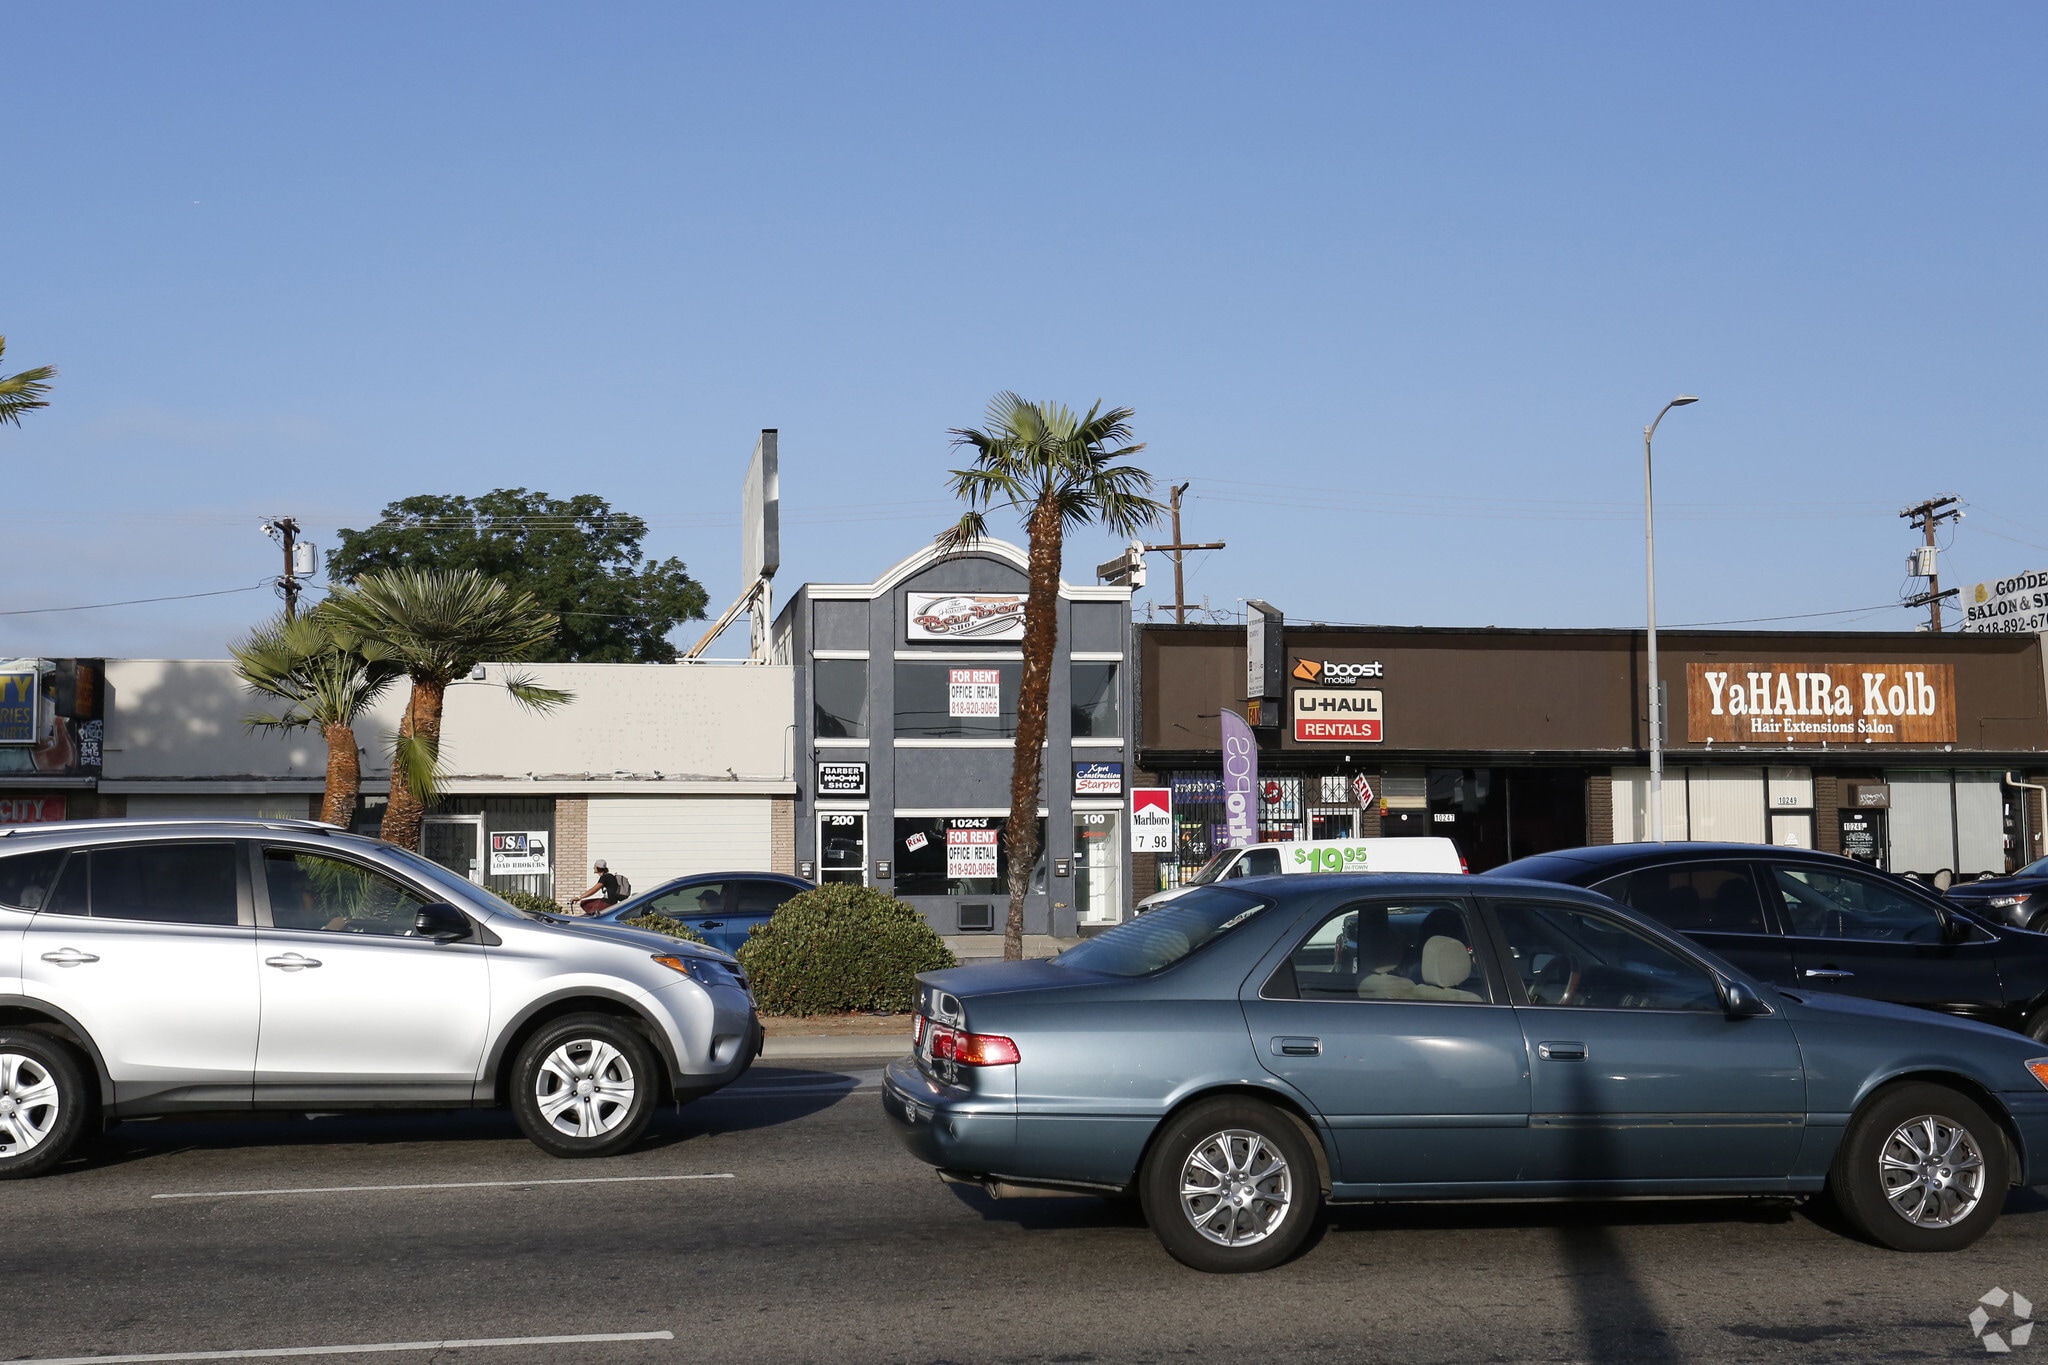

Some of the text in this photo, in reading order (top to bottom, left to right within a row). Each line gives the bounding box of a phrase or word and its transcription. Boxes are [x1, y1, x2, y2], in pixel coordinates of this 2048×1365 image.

[1996, 572, 2048, 596] GODDE
[1968, 599, 2018, 621] SALON
[2020, 596, 2031, 610] &
[950, 621, 977, 633] SHOP
[1978, 613, 2048, 633] 818-892-67
[1324, 661, 1383, 677] boost
[952, 671, 997, 683] FOR RENT
[952, 686, 972, 699] OFFICE
[977, 686, 997, 699] RETAIL
[1704, 671, 1936, 716] YaHAIRa Kolb
[952, 702, 997, 714] 818-920-9066
[1300, 698, 1377, 712] U-HAUL
[1305, 723, 1372, 736] RENTALS
[1751, 718, 1893, 734] Hair Extensions Salon
[825, 767, 860, 775] BARBER
[1076, 771, 1121, 780] Construction
[828, 782, 857, 790] SHOP
[1077, 780, 1120, 793] Starpro
[0, 799, 45, 821] CITY
[831, 816, 854, 826] 200
[950, 819, 987, 828] 10243
[1083, 814, 1105, 824] 100
[1133, 812, 1170, 826] Marlboro
[493, 835, 527, 850] USA
[907, 833, 925, 847] RENT
[949, 831, 995, 843] FOR RENT
[949, 847, 970, 860] OFFICE
[975, 847, 995, 860] RETAIL
[949, 863, 995, 875] 818-920-9066
